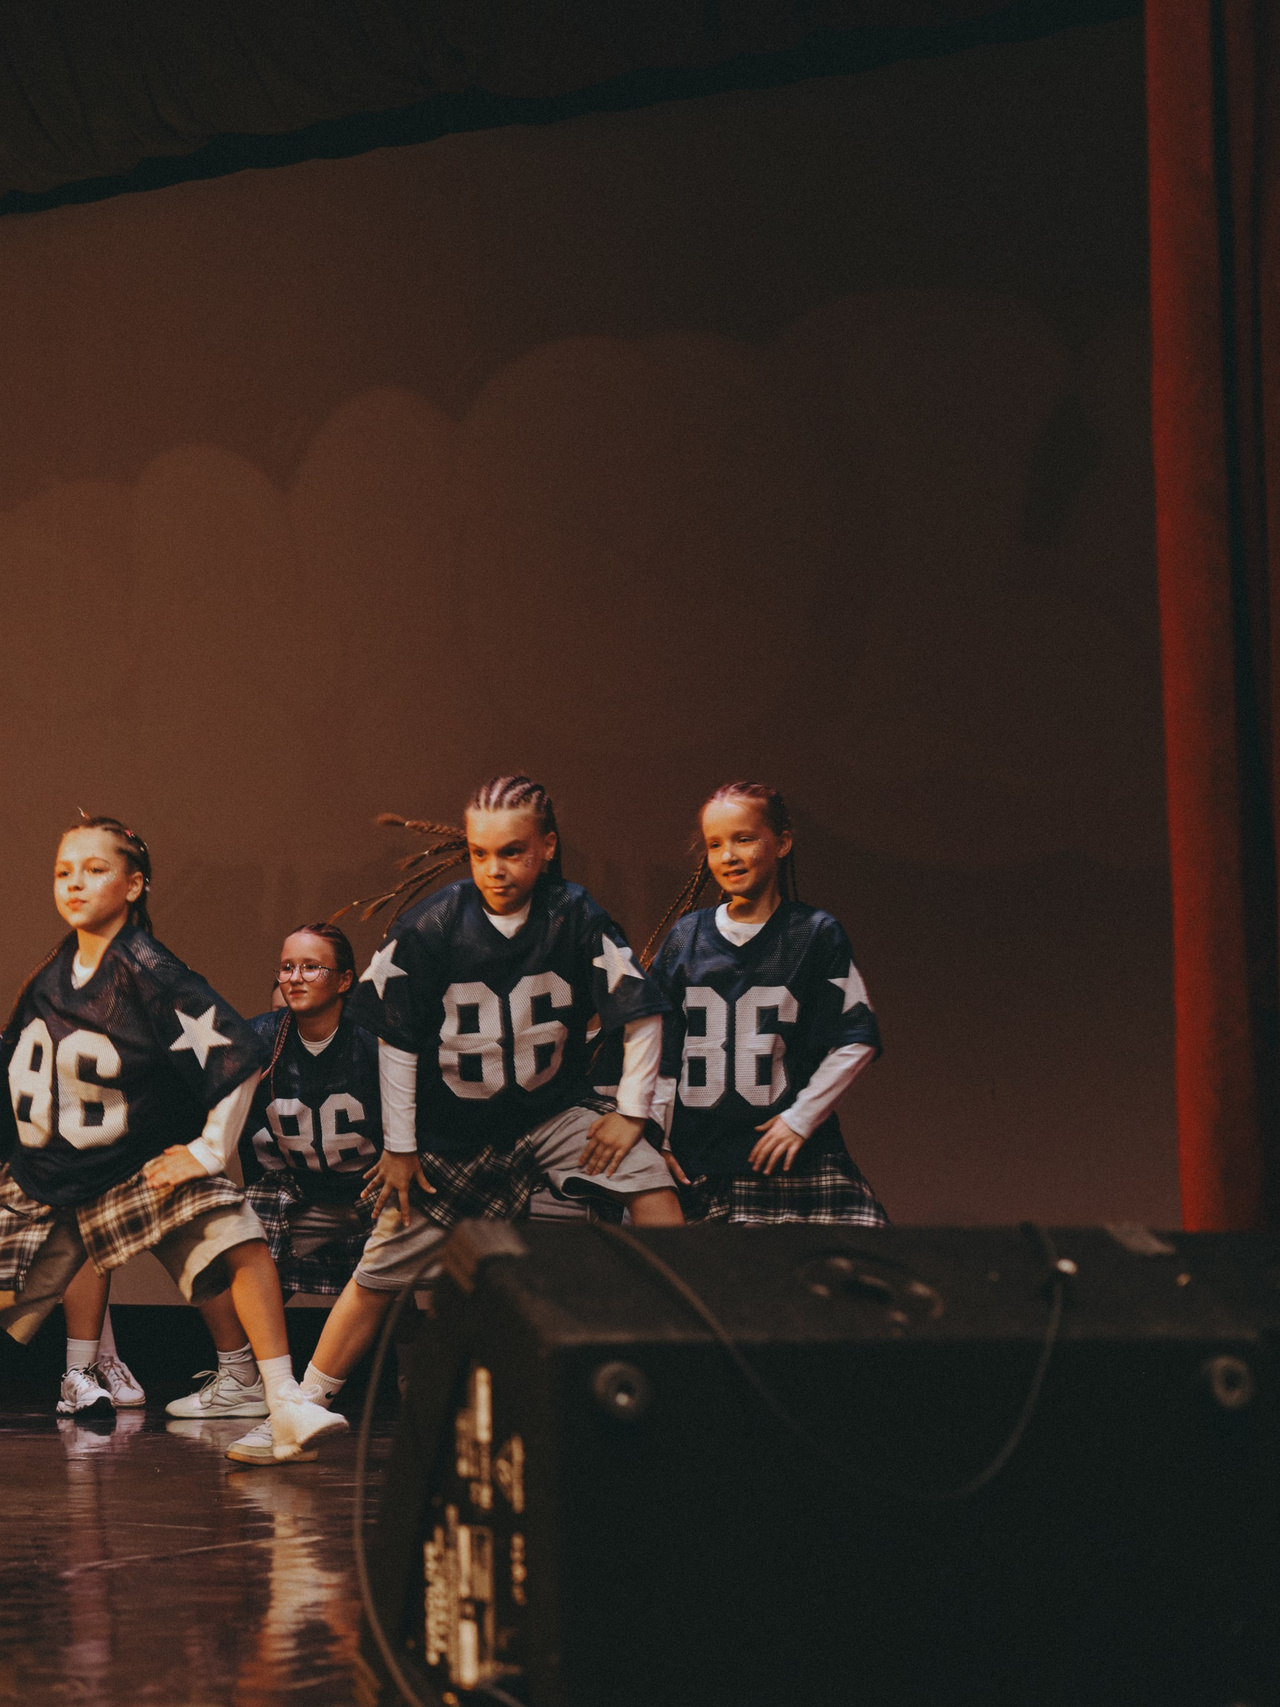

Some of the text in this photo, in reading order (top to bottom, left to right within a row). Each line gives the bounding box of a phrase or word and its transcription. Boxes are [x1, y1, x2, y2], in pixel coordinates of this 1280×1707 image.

[9, 1017, 129, 1150] 86
[439, 971, 573, 1100] 86
[678, 986, 800, 1107] 86
